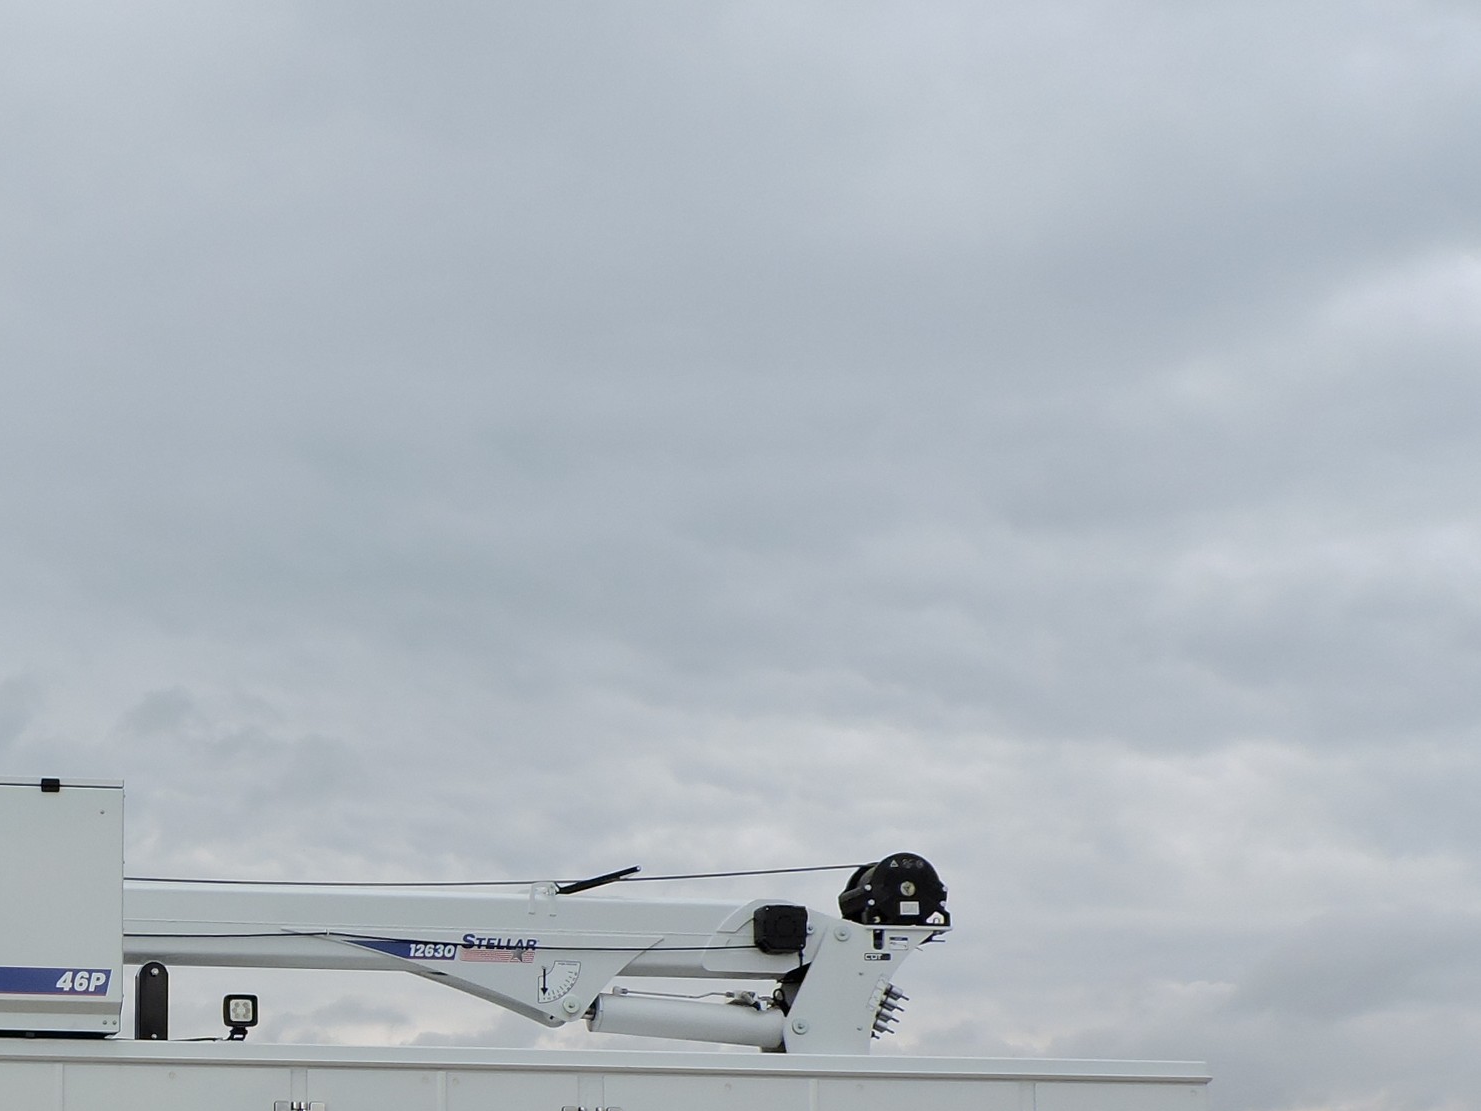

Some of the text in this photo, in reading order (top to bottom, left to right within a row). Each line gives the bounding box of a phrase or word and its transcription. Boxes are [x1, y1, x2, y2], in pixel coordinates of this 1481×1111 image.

[462, 934, 537, 950] STELLAR
[409, 943, 456, 958] 12630
[55, 970, 107, 992] 46P
